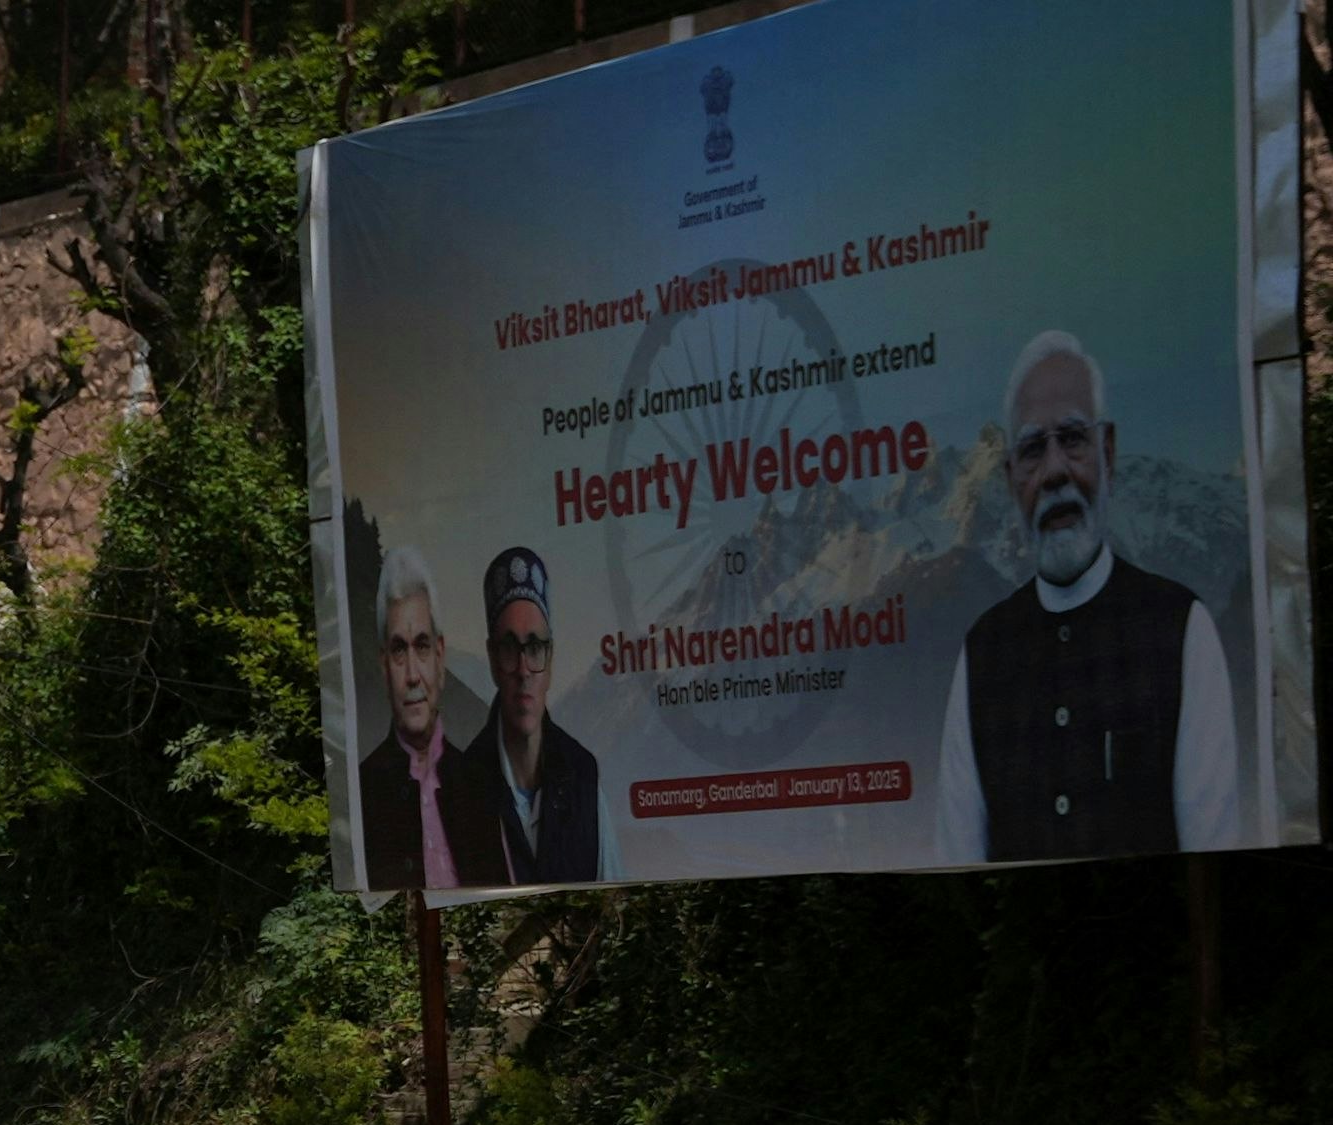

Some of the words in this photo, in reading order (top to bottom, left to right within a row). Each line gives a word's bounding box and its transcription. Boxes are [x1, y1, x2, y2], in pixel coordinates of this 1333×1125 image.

[684, 180, 744, 207] Government
[747, 174, 758, 192] of
[678, 210, 713, 229] Jammu
[714, 205, 722, 220] &
[725, 195, 765, 217] Kashmir
[494, 304, 560, 350] Viksit
[563, 289, 651, 337] Bharat,
[656, 267, 729, 316] Viksit
[734, 252, 835, 300] Jammu
[841, 241, 862, 277] &
[867, 210, 990, 272] Kashmir
[543, 397, 609, 438] People
[614, 388, 634, 422] of
[639, 380, 722, 418] Jammu
[729, 371, 744, 400] &
[749, 348, 847, 397] Kashmir
[853, 332, 936, 378] extend
[554, 453, 697, 530] Hearty
[706, 420, 929, 501] Welcome
[725, 548, 746, 576] to
[600, 623, 658, 676] Shri
[664, 611, 815, 669] Narendra
[823, 593, 907, 651] Modi
[657, 676, 719, 707] Hon'ble
[723, 673, 772, 701] Prime
[776, 666, 846, 696] Minister
[637, 788, 706, 809] Sonamarg,
[708, 779, 778, 803] Ganderbal
[787, 777, 845, 799] January
[846, 771, 864, 794] 13,
[866, 769, 901, 791] 2025
